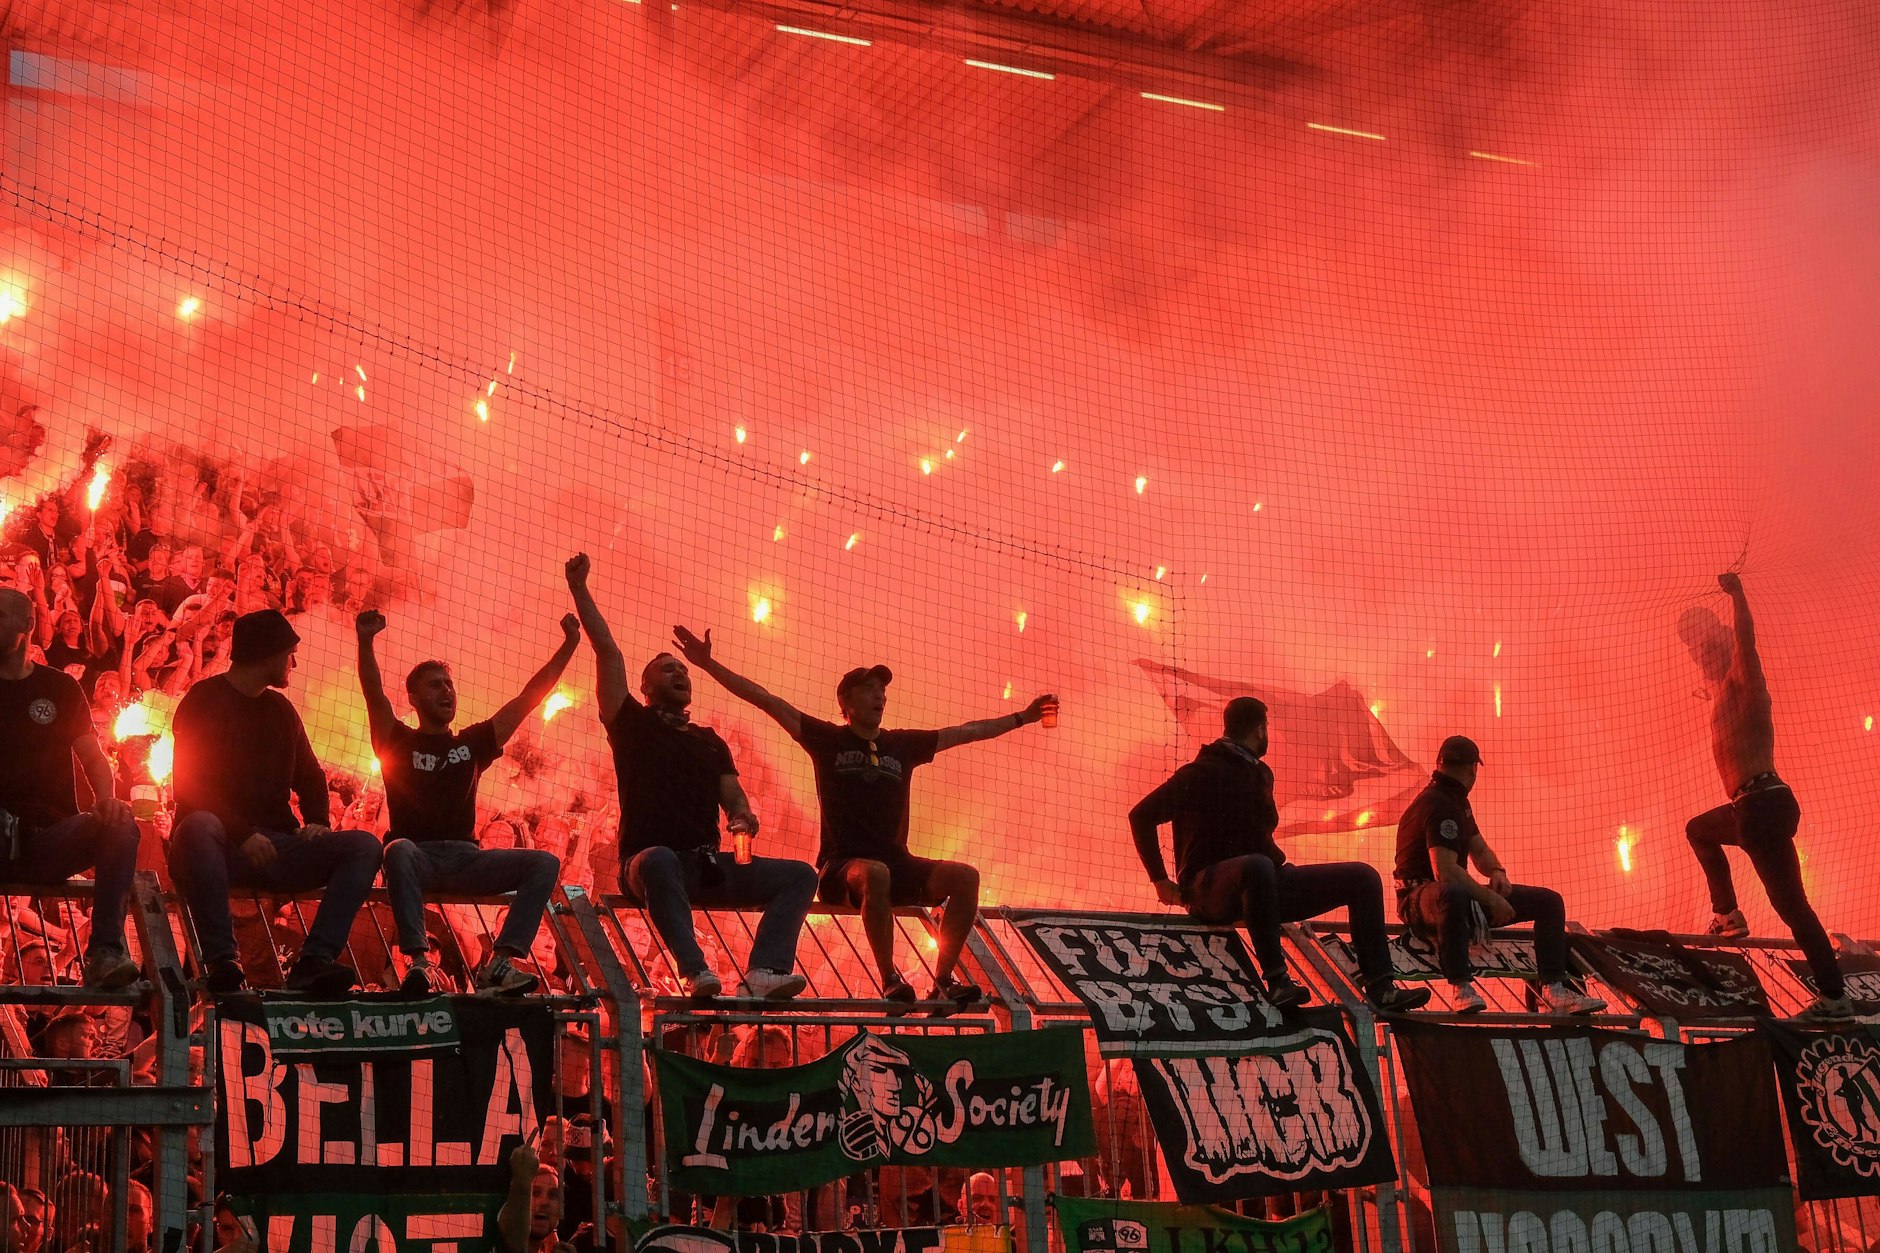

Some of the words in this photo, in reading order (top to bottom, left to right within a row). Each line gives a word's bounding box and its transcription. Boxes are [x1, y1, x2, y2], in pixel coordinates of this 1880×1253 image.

[36, 704, 51, 718] 96
[1035, 925, 1252, 981] FUCK
[267, 1011, 345, 1040] rote
[351, 1010, 452, 1040] kurve
[221, 1018, 540, 1168] BELLA
[934, 1059, 1070, 1147] Society
[1490, 1037, 1701, 1182] WEST
[896, 1108, 931, 1149] 96
[1121, 1227, 1140, 1241] 96
